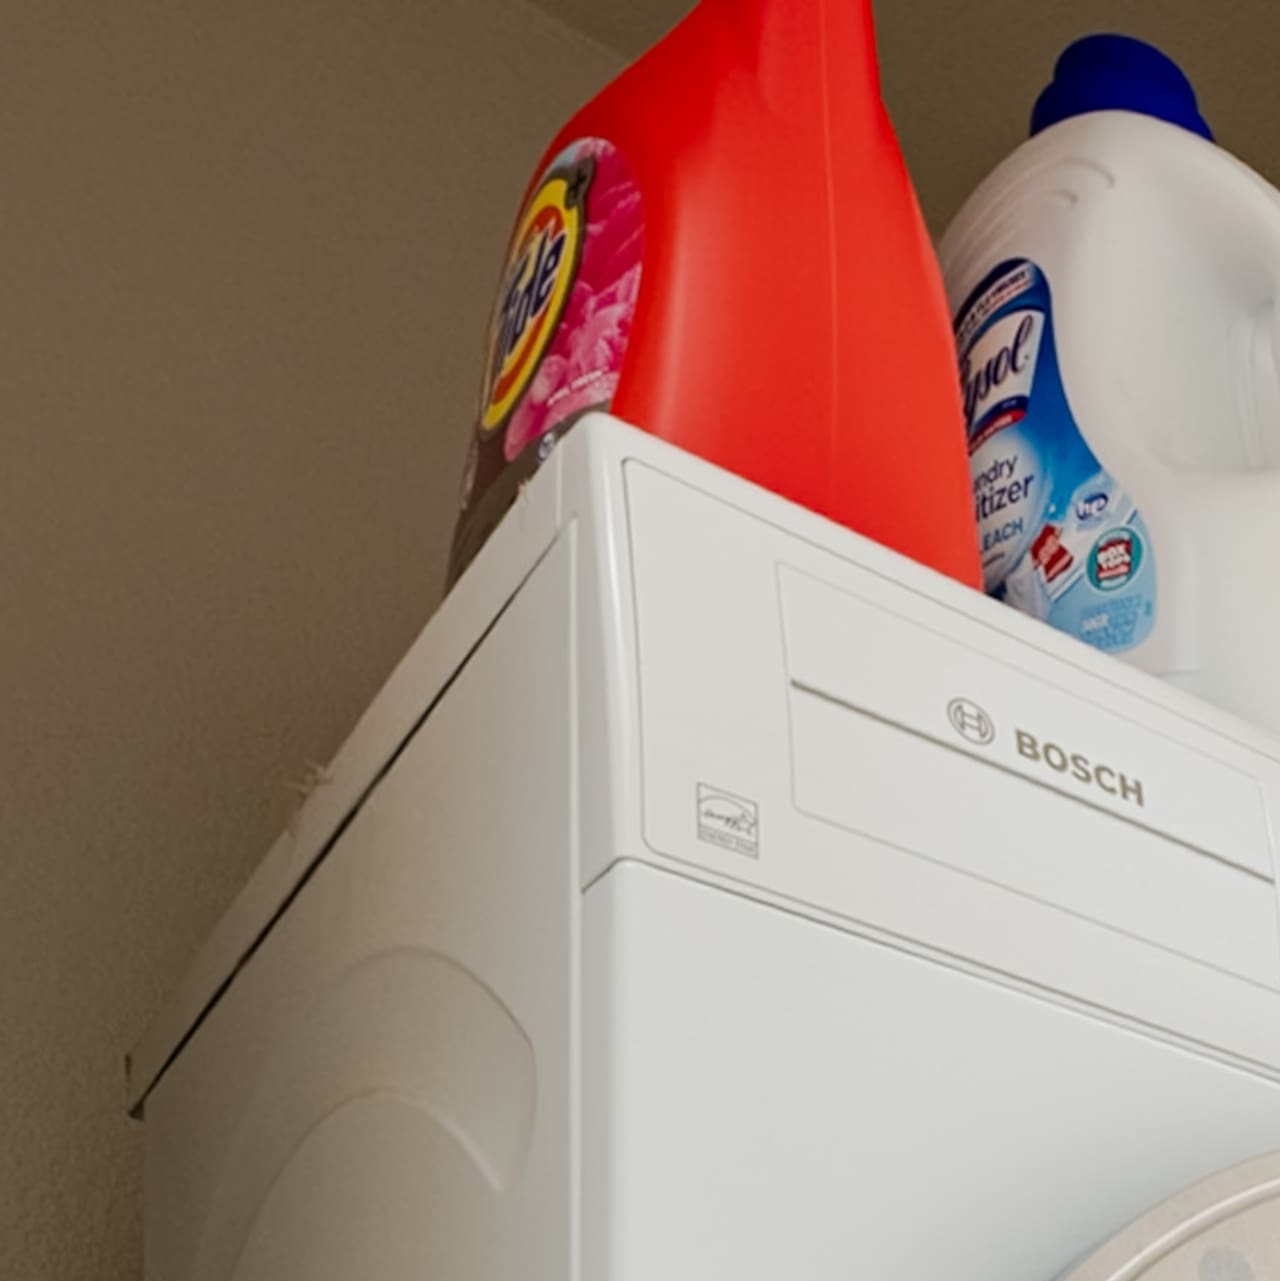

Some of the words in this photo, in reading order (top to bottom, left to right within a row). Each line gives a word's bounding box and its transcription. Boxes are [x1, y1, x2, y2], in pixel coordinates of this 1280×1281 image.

[963, 314, 1033, 440] ysol
[973, 455, 1018, 494] ndry
[975, 474, 1034, 524] itizer
[982, 517, 1024, 552] EACH
[1015, 728, 1144, 808] BOSCH
